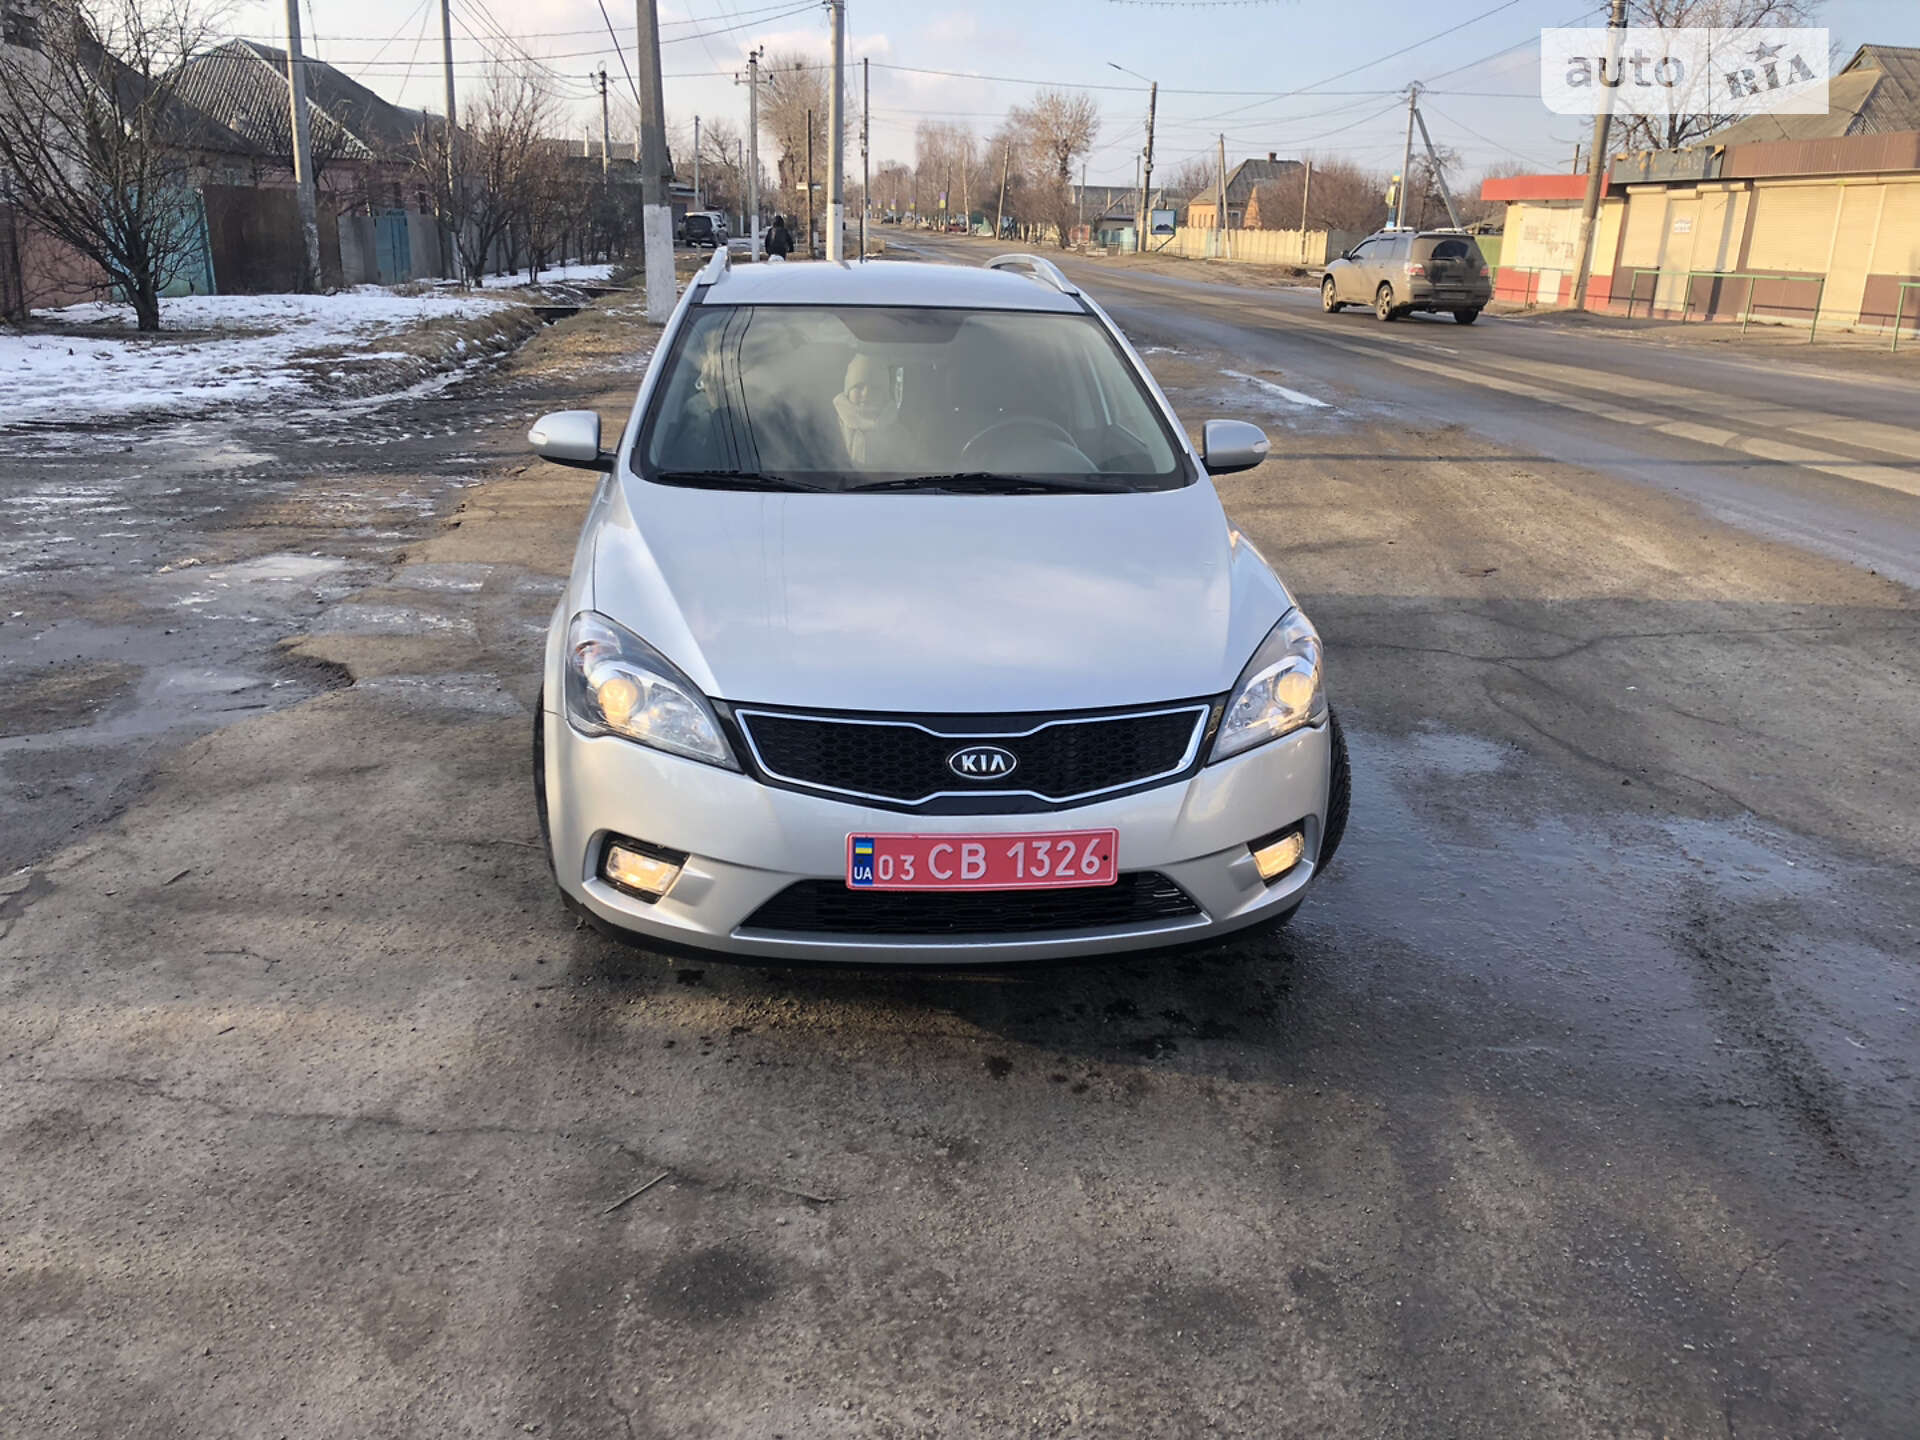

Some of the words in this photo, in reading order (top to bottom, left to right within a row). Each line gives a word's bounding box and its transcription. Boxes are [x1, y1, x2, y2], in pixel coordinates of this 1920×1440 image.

[961, 754, 1007, 772] KIA
[878, 855, 915, 881] 03
[928, 843, 987, 880] CB
[1006, 838, 1101, 878] 1326
[853, 866, 873, 880] UA
